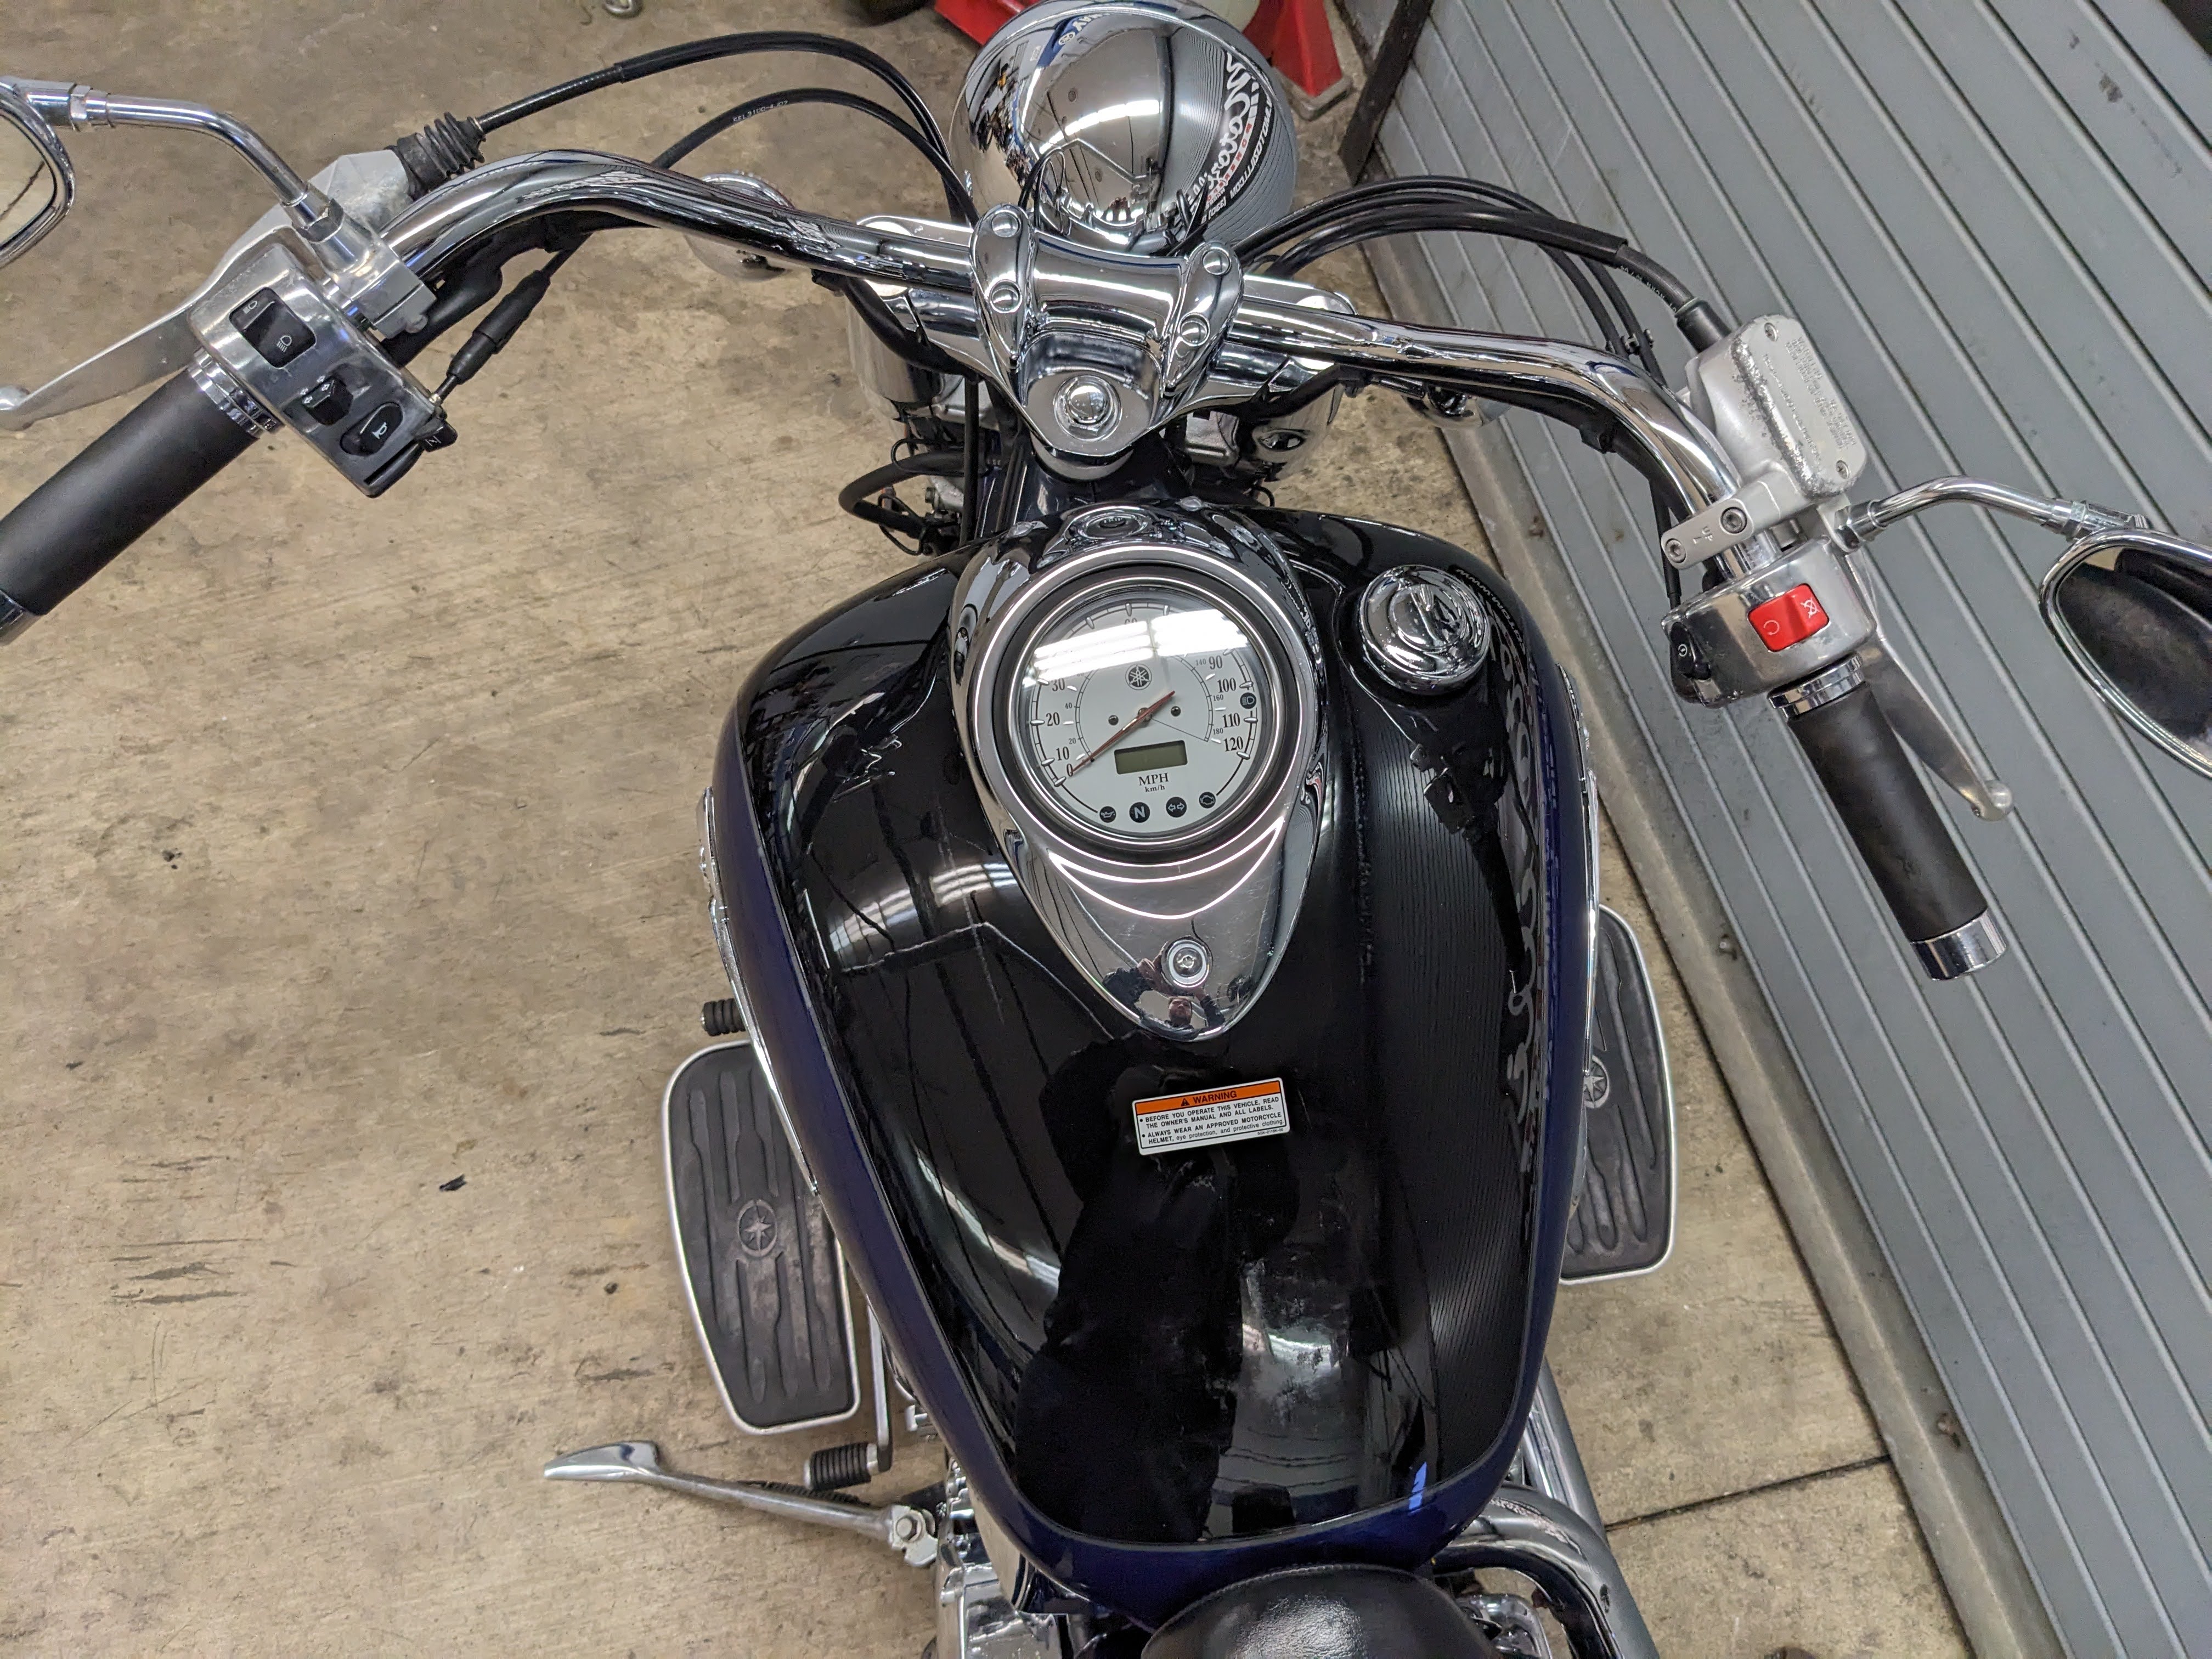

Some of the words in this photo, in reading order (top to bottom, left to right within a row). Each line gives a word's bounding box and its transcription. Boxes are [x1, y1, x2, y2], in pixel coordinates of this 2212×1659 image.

[1209, 655, 1223, 670] 90
[1052, 678, 1065, 691] 30
[1217, 678, 1237, 693] 100
[1046, 712, 1060, 726] 20
[1222, 713, 1240, 729] 110
[1223, 736, 1244, 752] 120
[1056, 746, 1069, 761] 10
[1066, 763, 1074, 777] 0
[1138, 772, 1169, 786] MPH
[1134, 806, 1146, 819] N
[1193, 1091, 1237, 1104] WARNING
[1146, 1114, 1169, 1122] BEFORE
[1187, 1107, 1215, 1116] OPERATE
[1234, 1100, 1261, 1109] VEHICLE,
[1161, 1118, 1188, 1127] OWNER'S
[1191, 1114, 1216, 1122] MANUAL
[1249, 1104, 1273, 1113] LABELS.
[1148, 1130, 1171, 1138] ALWAYS
[1206, 1119, 1239, 1129] APPROVED
[1242, 1111, 1282, 1124] MOTORCYCLE
[1148, 1136, 1174, 1144] HELMET,
[1189, 1130, 1218, 1139] protection,
[1233, 1123, 1260, 1132] protective
